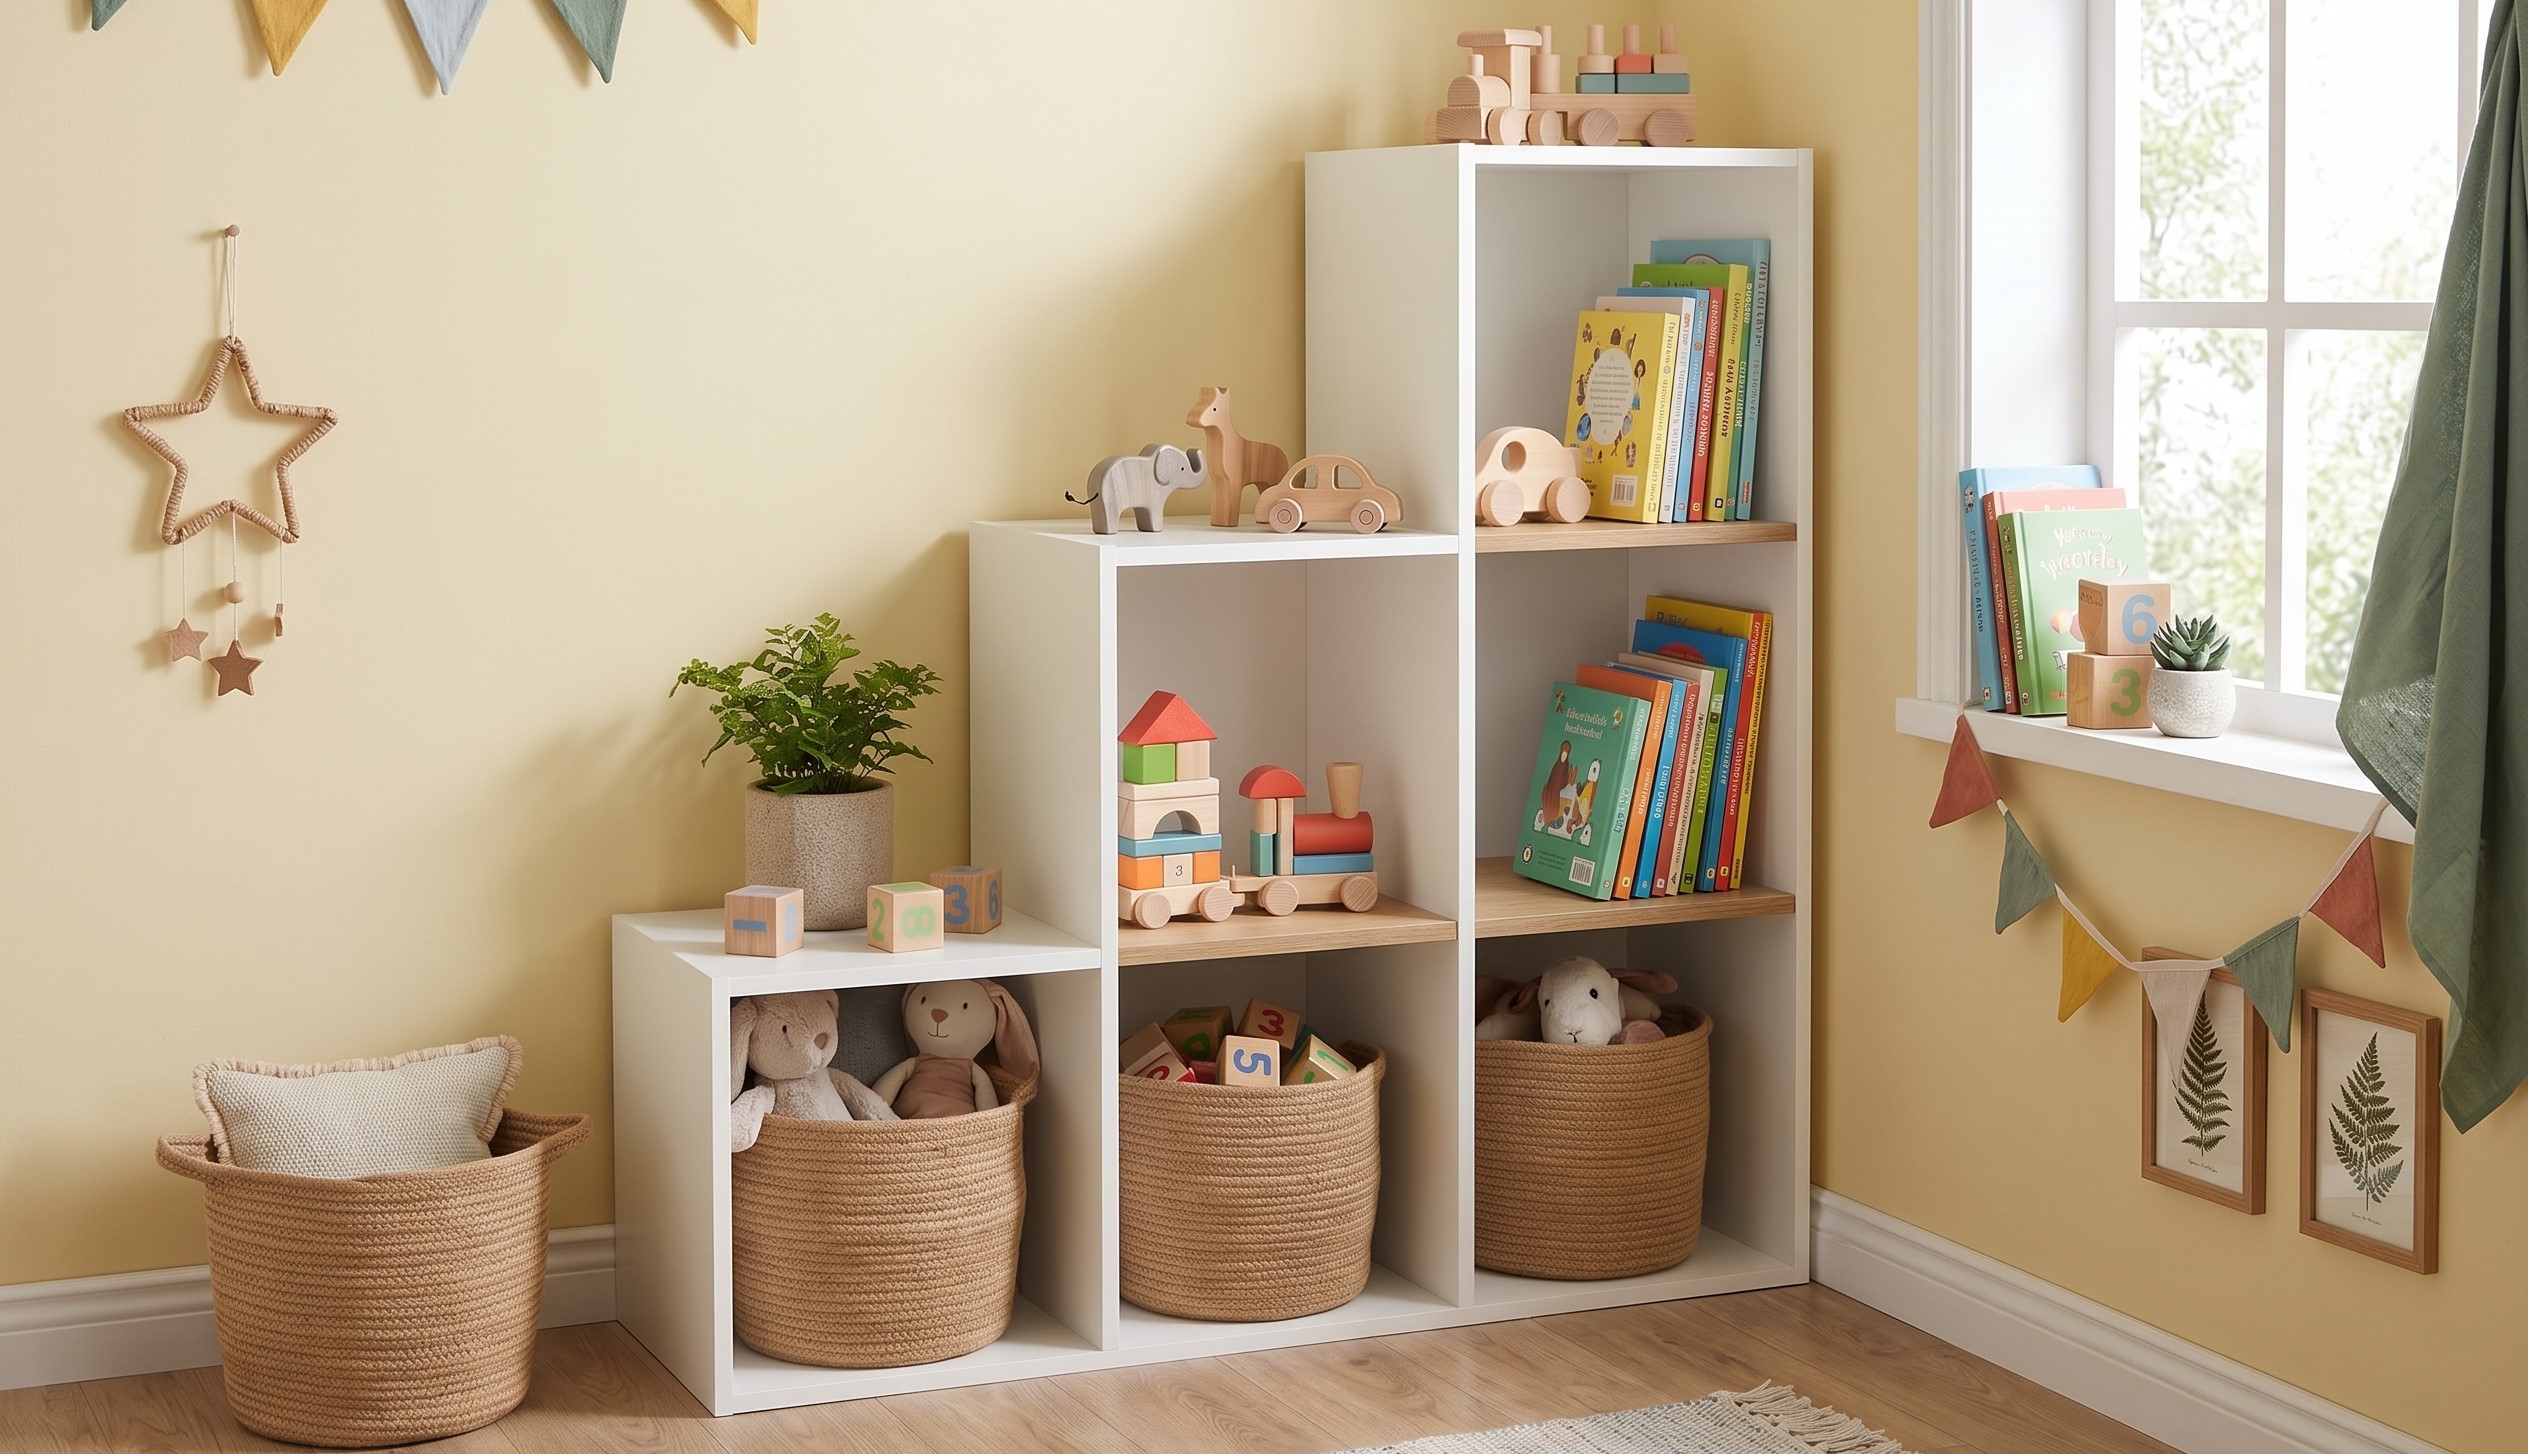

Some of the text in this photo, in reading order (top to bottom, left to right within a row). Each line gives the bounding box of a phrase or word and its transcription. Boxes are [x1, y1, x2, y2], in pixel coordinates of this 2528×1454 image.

[2122, 594, 2157, 645] 6
[2110, 668, 2141, 717] 3
[1175, 865, 1183, 876] 3
[871, 897, 885, 942] 2
[944, 883, 970, 925] 3
[988, 880, 999, 920] 6
[1257, 1009, 1285, 1037] 3
[1233, 1048, 1272, 1076] 5
